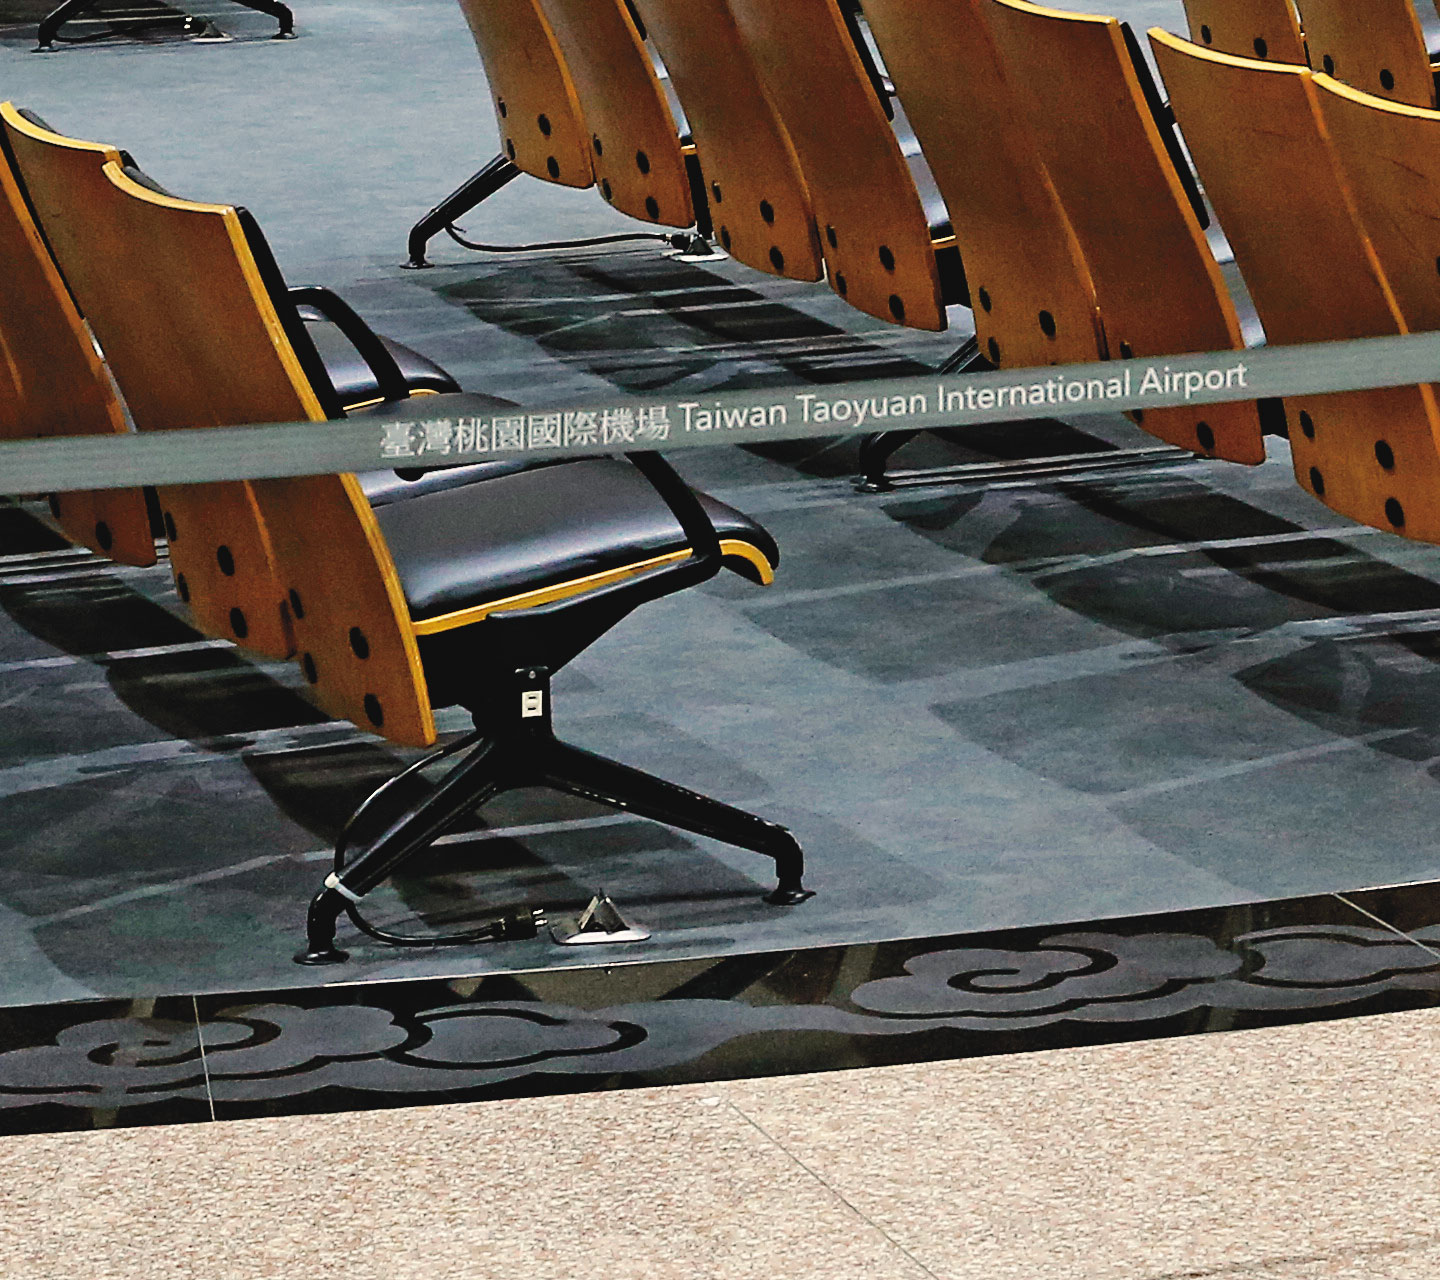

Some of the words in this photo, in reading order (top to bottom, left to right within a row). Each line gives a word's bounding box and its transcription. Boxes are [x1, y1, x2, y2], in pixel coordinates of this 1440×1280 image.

[381, 406, 670, 459] 臺灣桃園國際機場
[678, 402, 787, 433] Taiwan
[796, 393, 928, 427] Taoyuan
[938, 369, 1130, 414] International
[1139, 363, 1248, 400] Airport
